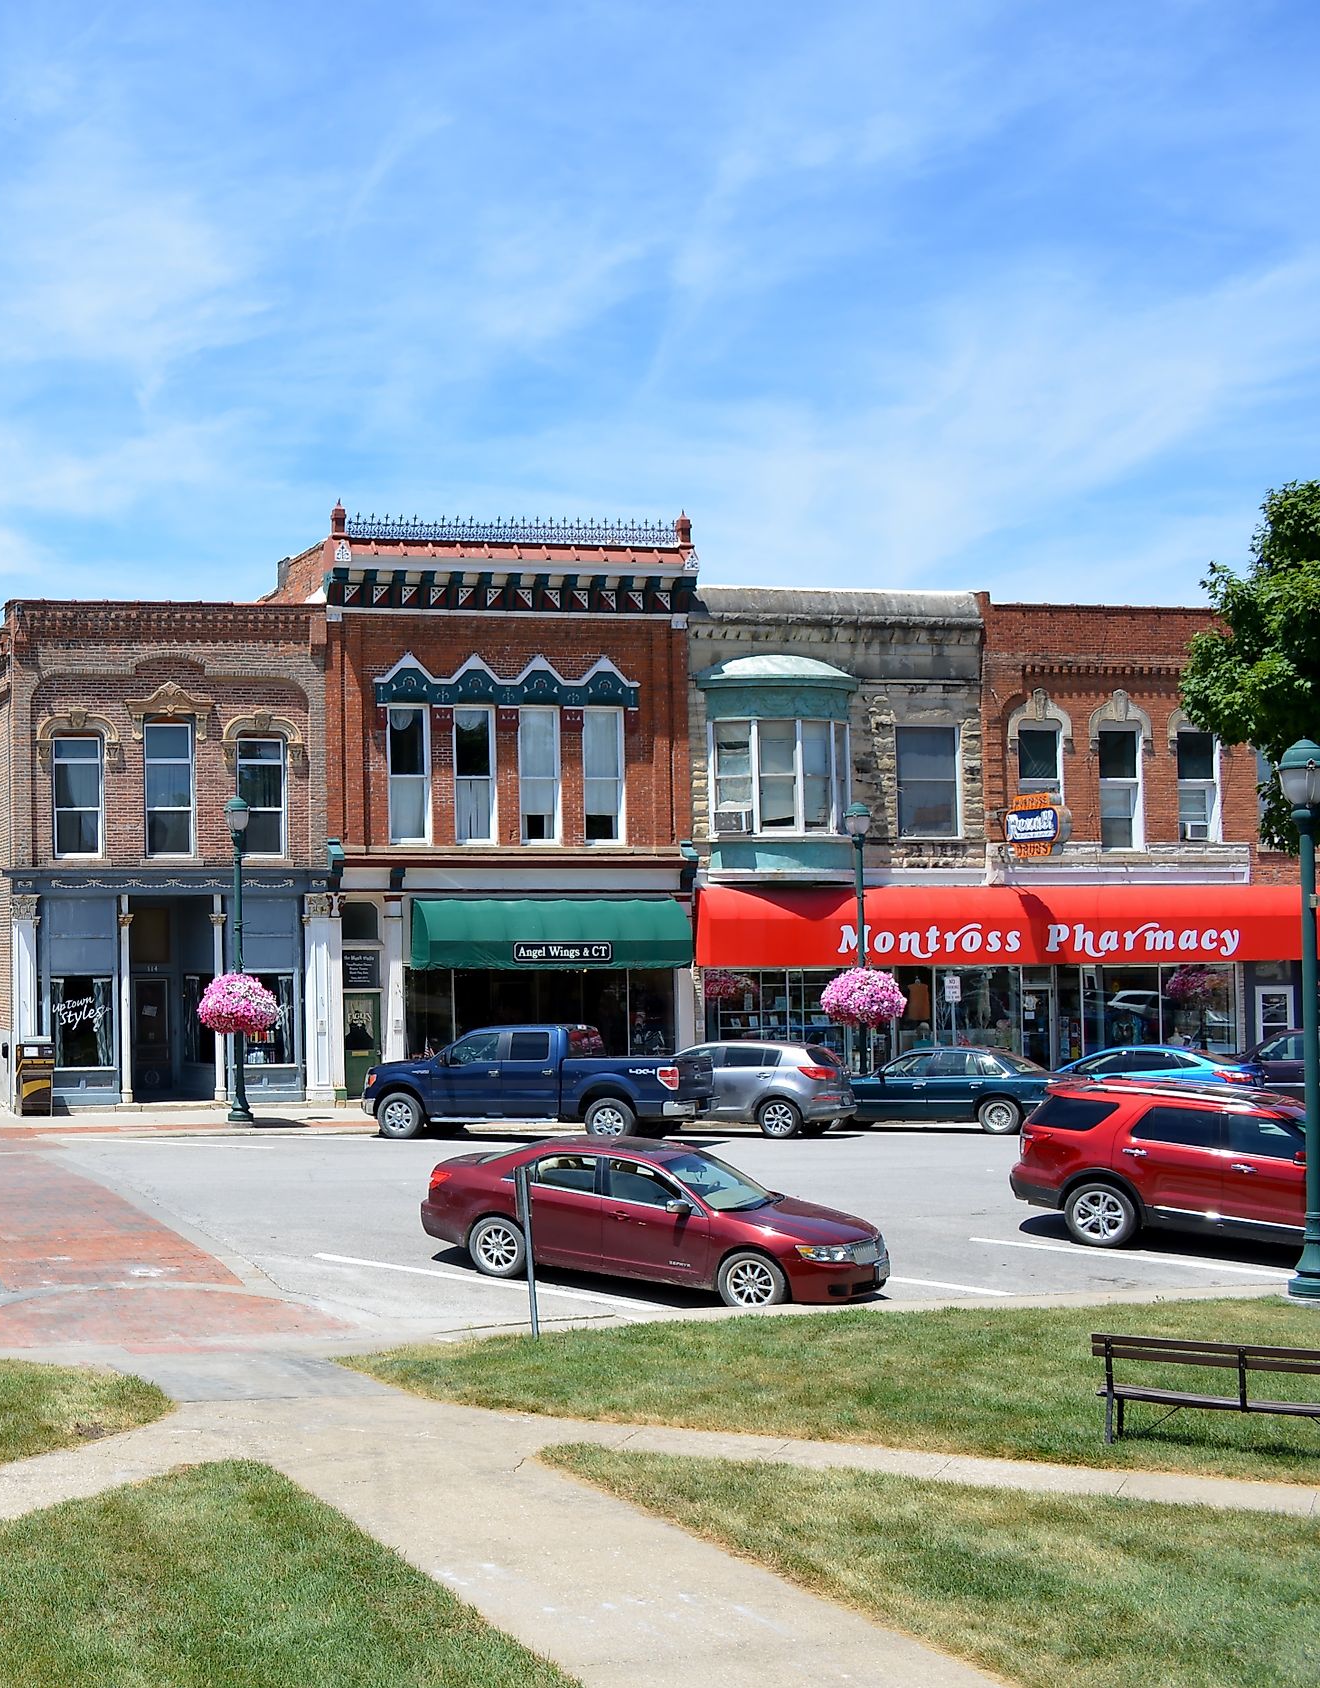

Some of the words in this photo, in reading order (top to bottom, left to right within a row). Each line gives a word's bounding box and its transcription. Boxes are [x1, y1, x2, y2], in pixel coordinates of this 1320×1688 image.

[1006, 810, 1055, 841] Rexall
[1016, 842, 1048, 857] DRUGS
[518, 945, 546, 959] Angel
[548, 945, 580, 959] Wings
[582, 947, 590, 957] &
[591, 945, 608, 957] CT
[837, 923, 1021, 958] Montross
[1045, 922, 1240, 957] Pharmacy
[60, 1004, 106, 1031] Styles
